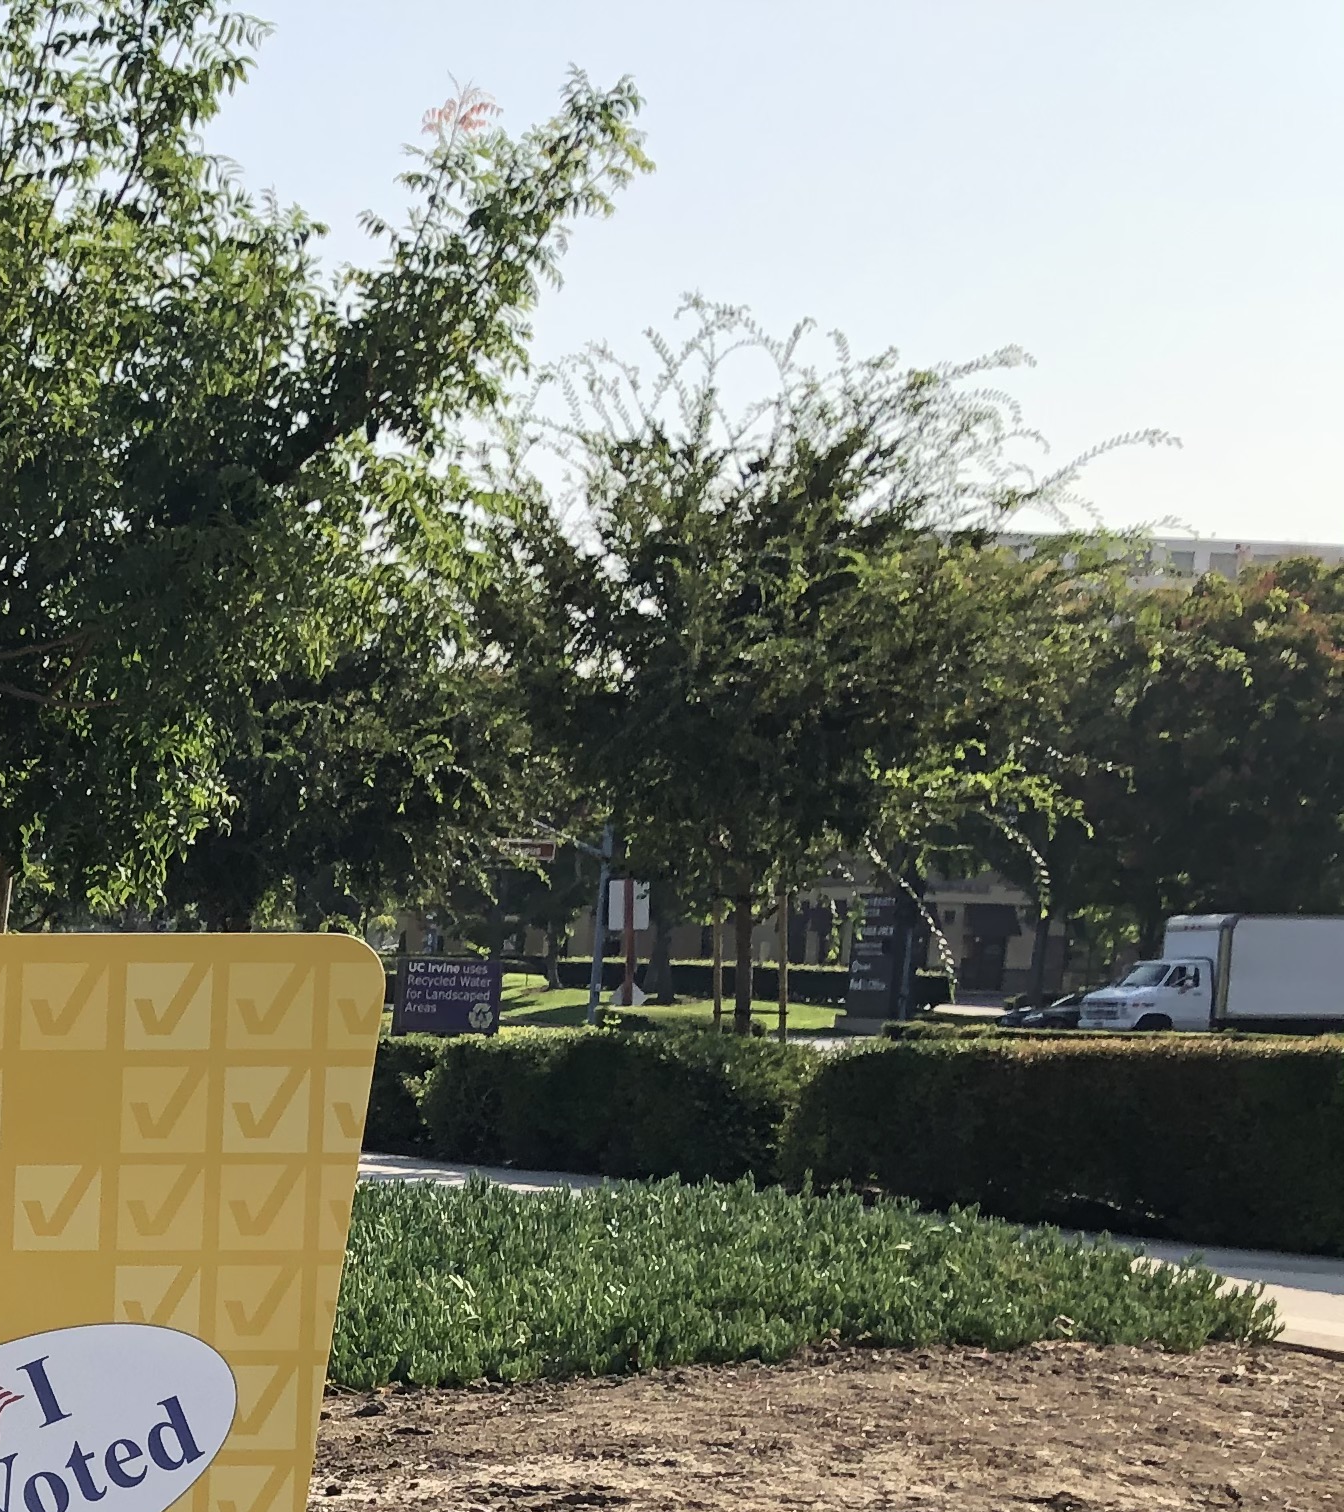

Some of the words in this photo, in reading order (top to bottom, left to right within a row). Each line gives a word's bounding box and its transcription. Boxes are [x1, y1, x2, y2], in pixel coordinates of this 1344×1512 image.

[409, 962, 425, 972] UC
[428, 963, 460, 973] Irvine
[463, 965, 488, 974] uses
[407, 975, 456, 987] Recycled
[460, 976, 491, 987] Water
[406, 988, 421, 999] for
[426, 990, 490, 1002] Landscaped
[405, 1002, 436, 1012] Areas
[16, 1355, 73, 1429] I
